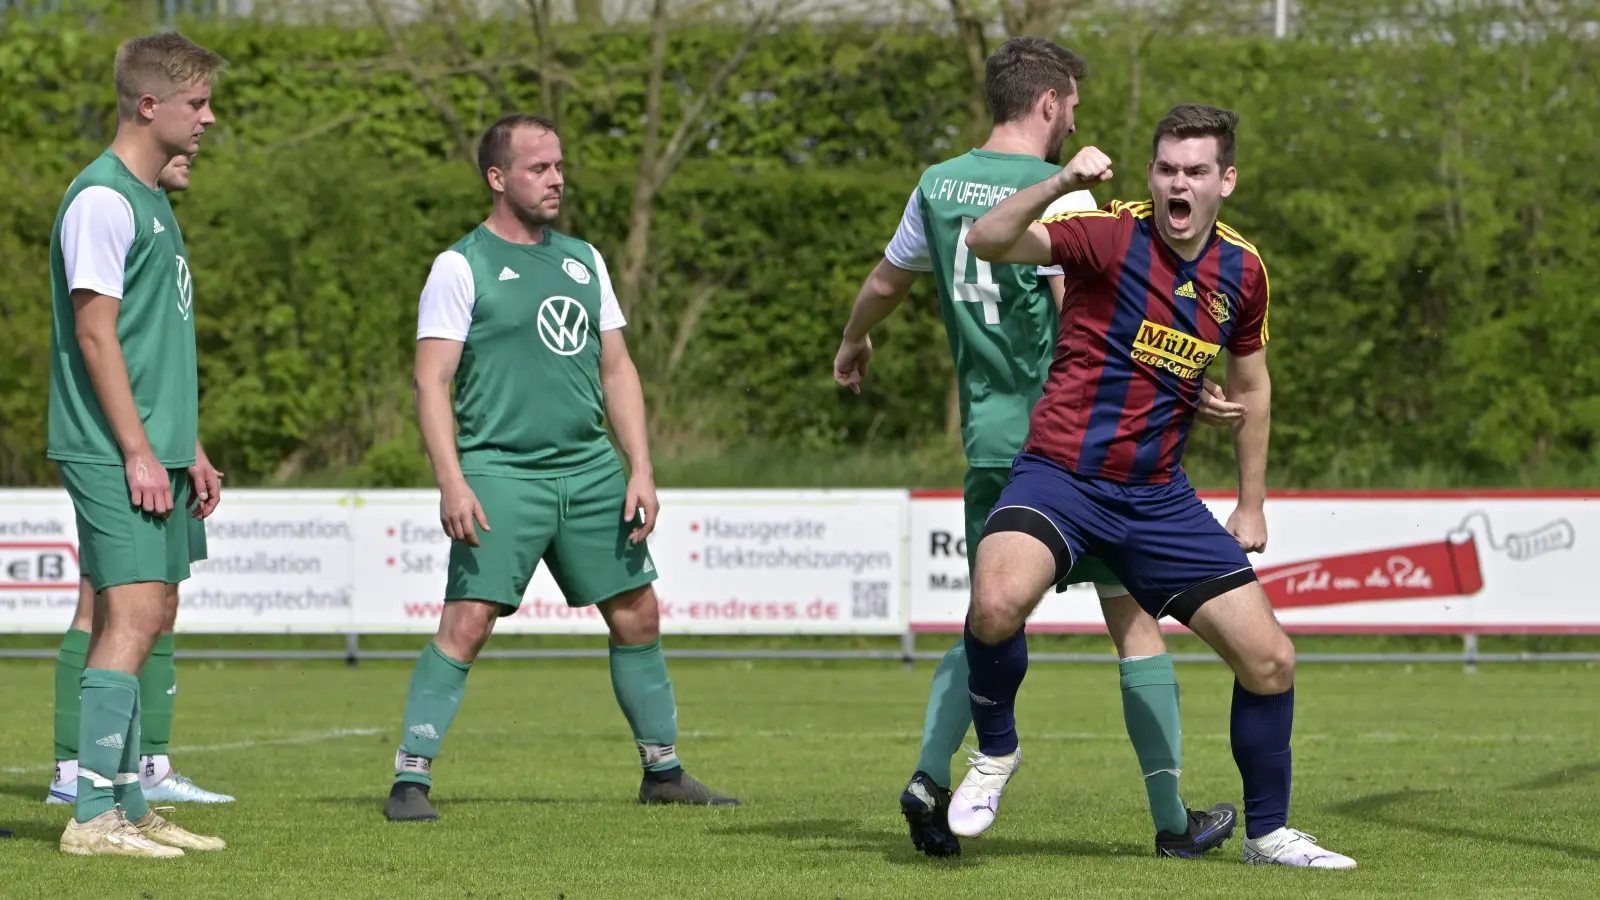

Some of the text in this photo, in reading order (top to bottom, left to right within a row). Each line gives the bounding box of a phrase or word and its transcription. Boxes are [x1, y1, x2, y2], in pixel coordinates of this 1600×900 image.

[930, 178, 1018, 206] 1. FV UFFENHE
[953, 216, 1002, 325] 4
[1137, 325, 1217, 367] Müller
[704, 518, 827, 545] Hausgeräte
[401, 551, 449, 574] Sat-
[704, 546, 891, 573] Elektroheizungen
